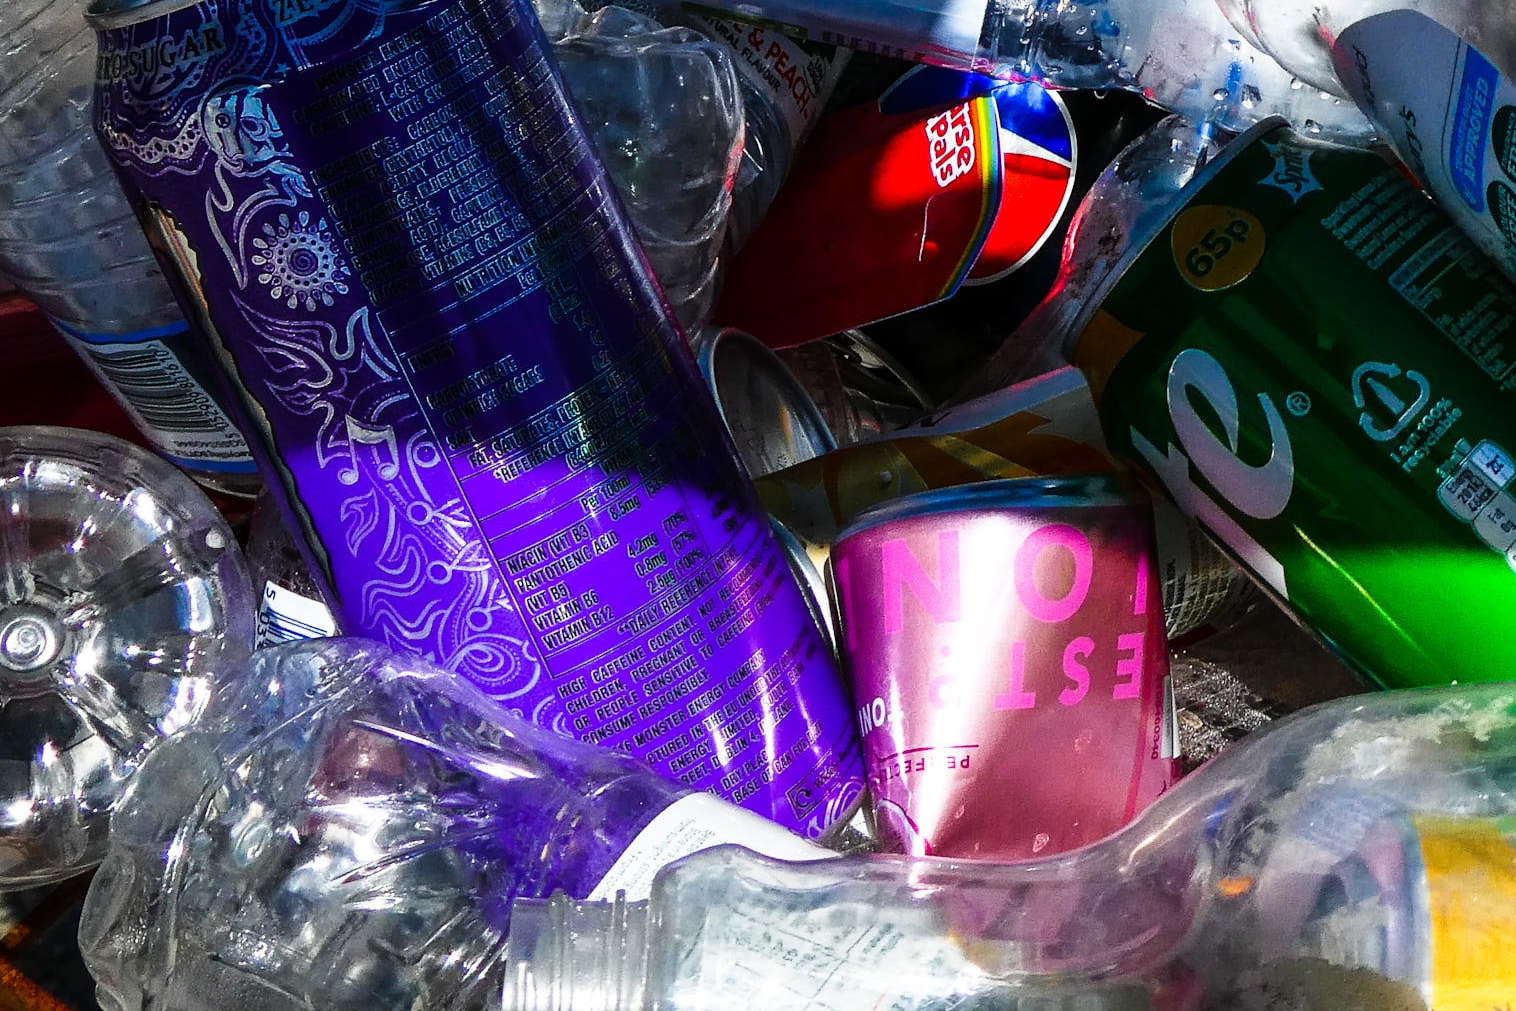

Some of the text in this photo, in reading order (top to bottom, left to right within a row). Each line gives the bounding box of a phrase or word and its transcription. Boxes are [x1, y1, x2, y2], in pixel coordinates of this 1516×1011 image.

[739, 44, 784, 94] FLAVOUR
[754, 41, 821, 113] PEACH
[925, 114, 960, 182] Pals
[1461, 76, 1491, 184] APPROVED
[1177, 208, 1258, 283] 65p
[1393, 405, 1471, 474] recyclable
[1394, 394, 1458, 458] am 100%
[1443, 465, 1477, 496] Energy
[505, 521, 594, 576] NIACIN (VIT B3)
[1486, 505, 1507, 526] Fat
[513, 529, 621, 594] PANTOTHENIC ACID
[523, 531, 662, 616] (VIT 4.2mg
[532, 549, 670, 634] VITAMIN B6 0.8mg
[654, 567, 721, 616] REFERENCE
[540, 604, 616, 652] VITAMIN B12
[556, 598, 719, 700] HIGH CAFFEINE NOT
[627, 628, 707, 682] PREGNANT OR
[571, 606, 761, 731] OR PEOPLE SENSITIVE TO CAFFEINE
[626, 647, 772, 751] MONSTER ENERGY COMPANY
[688, 665, 784, 740] IN THE EU THE
